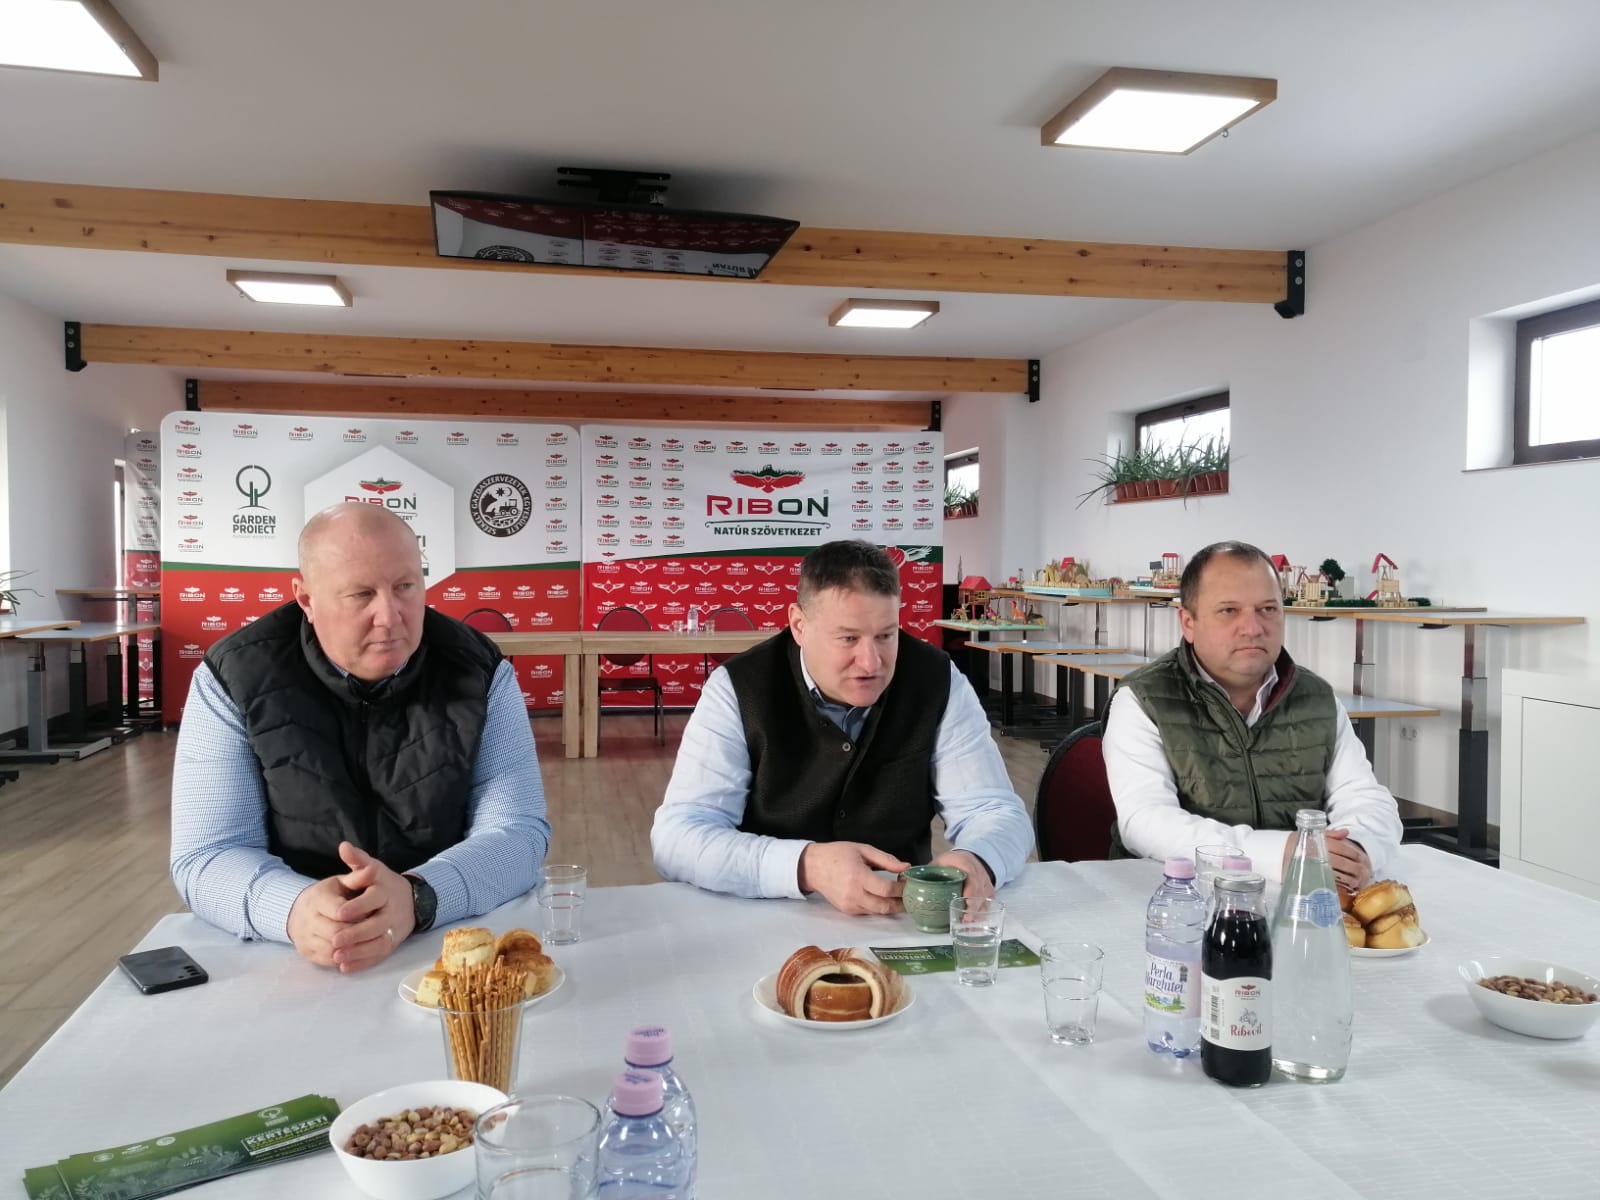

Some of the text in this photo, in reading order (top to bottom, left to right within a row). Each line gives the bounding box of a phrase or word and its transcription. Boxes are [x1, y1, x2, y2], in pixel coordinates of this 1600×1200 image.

[707, 495, 829, 517] RIBON
[232, 515, 276, 524] GARDEN
[232, 525, 276, 534] PROIECT
[714, 525, 822, 536] NATÚR SZÖVETKEZET
[1150, 962, 1172, 981] Perla
